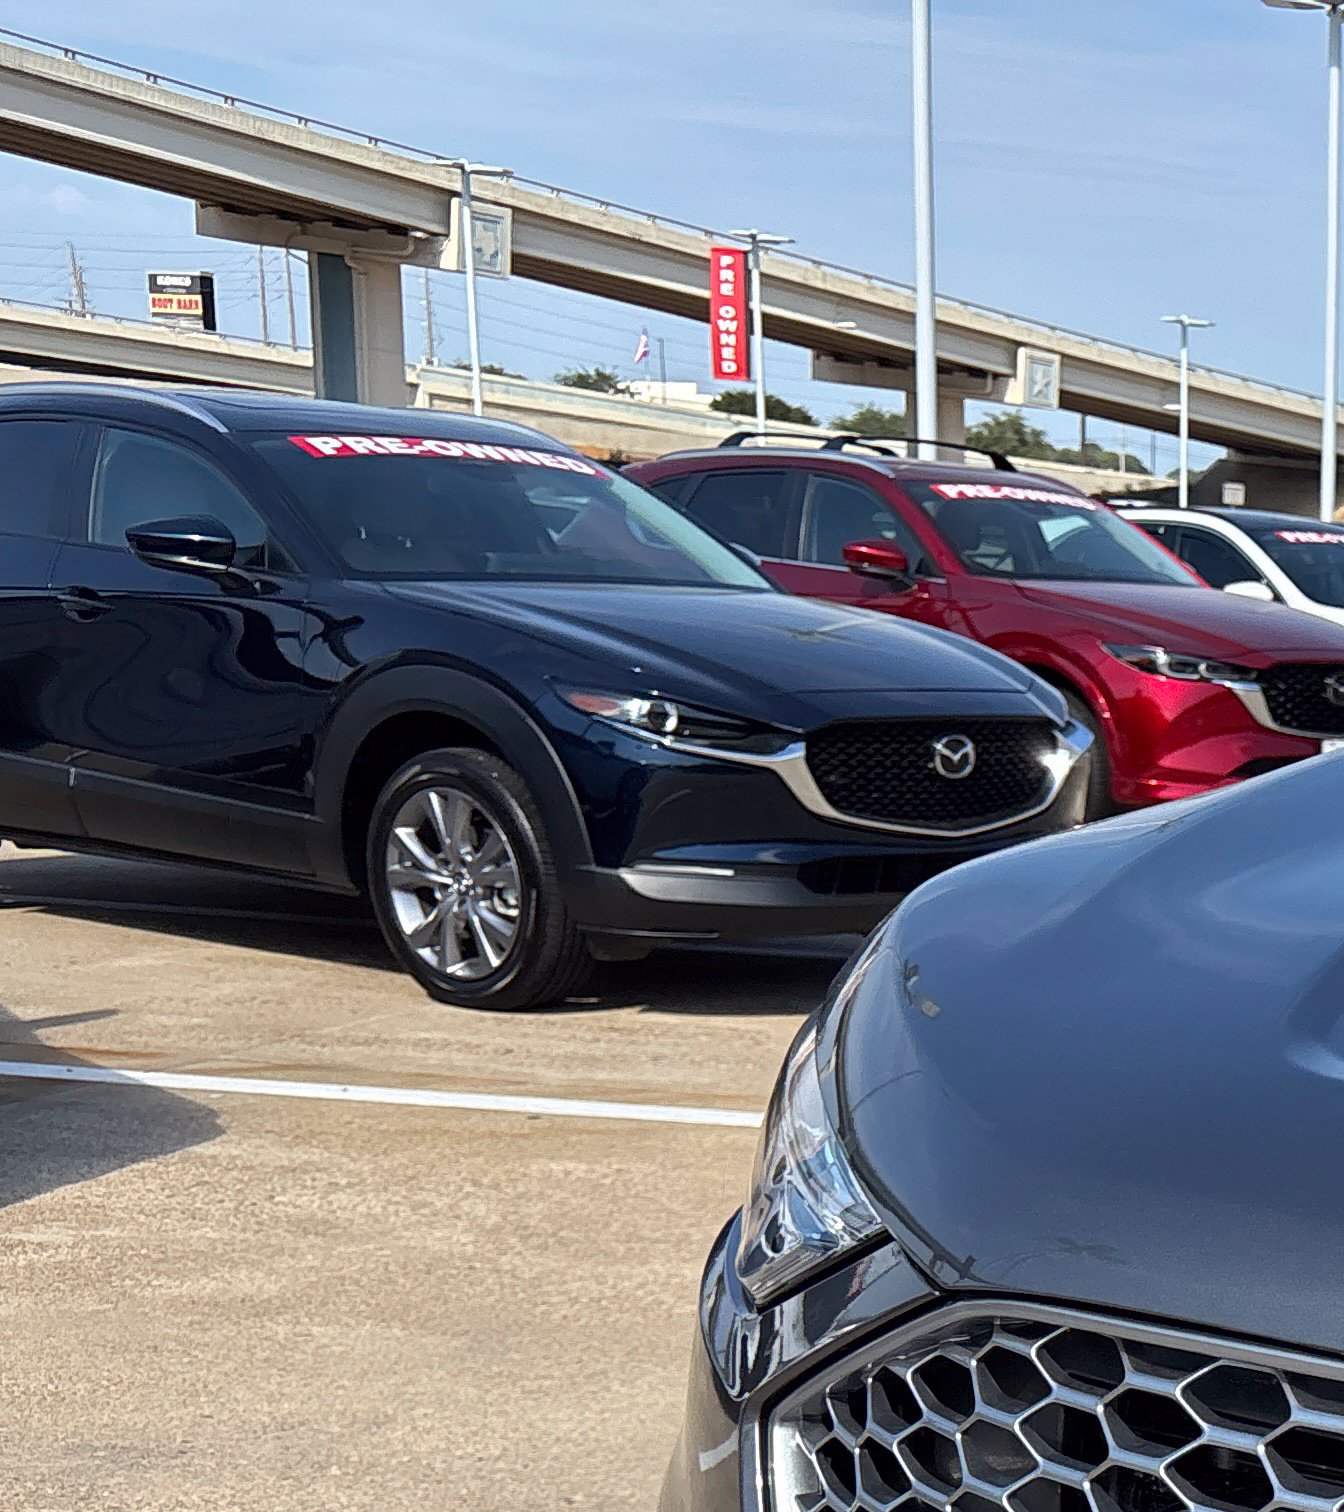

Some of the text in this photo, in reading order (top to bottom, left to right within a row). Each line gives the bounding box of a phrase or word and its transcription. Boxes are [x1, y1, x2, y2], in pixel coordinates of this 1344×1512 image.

[716, 255, 738, 373] PRE OWNED
[305, 436, 596, 475] PRE-OWNED
